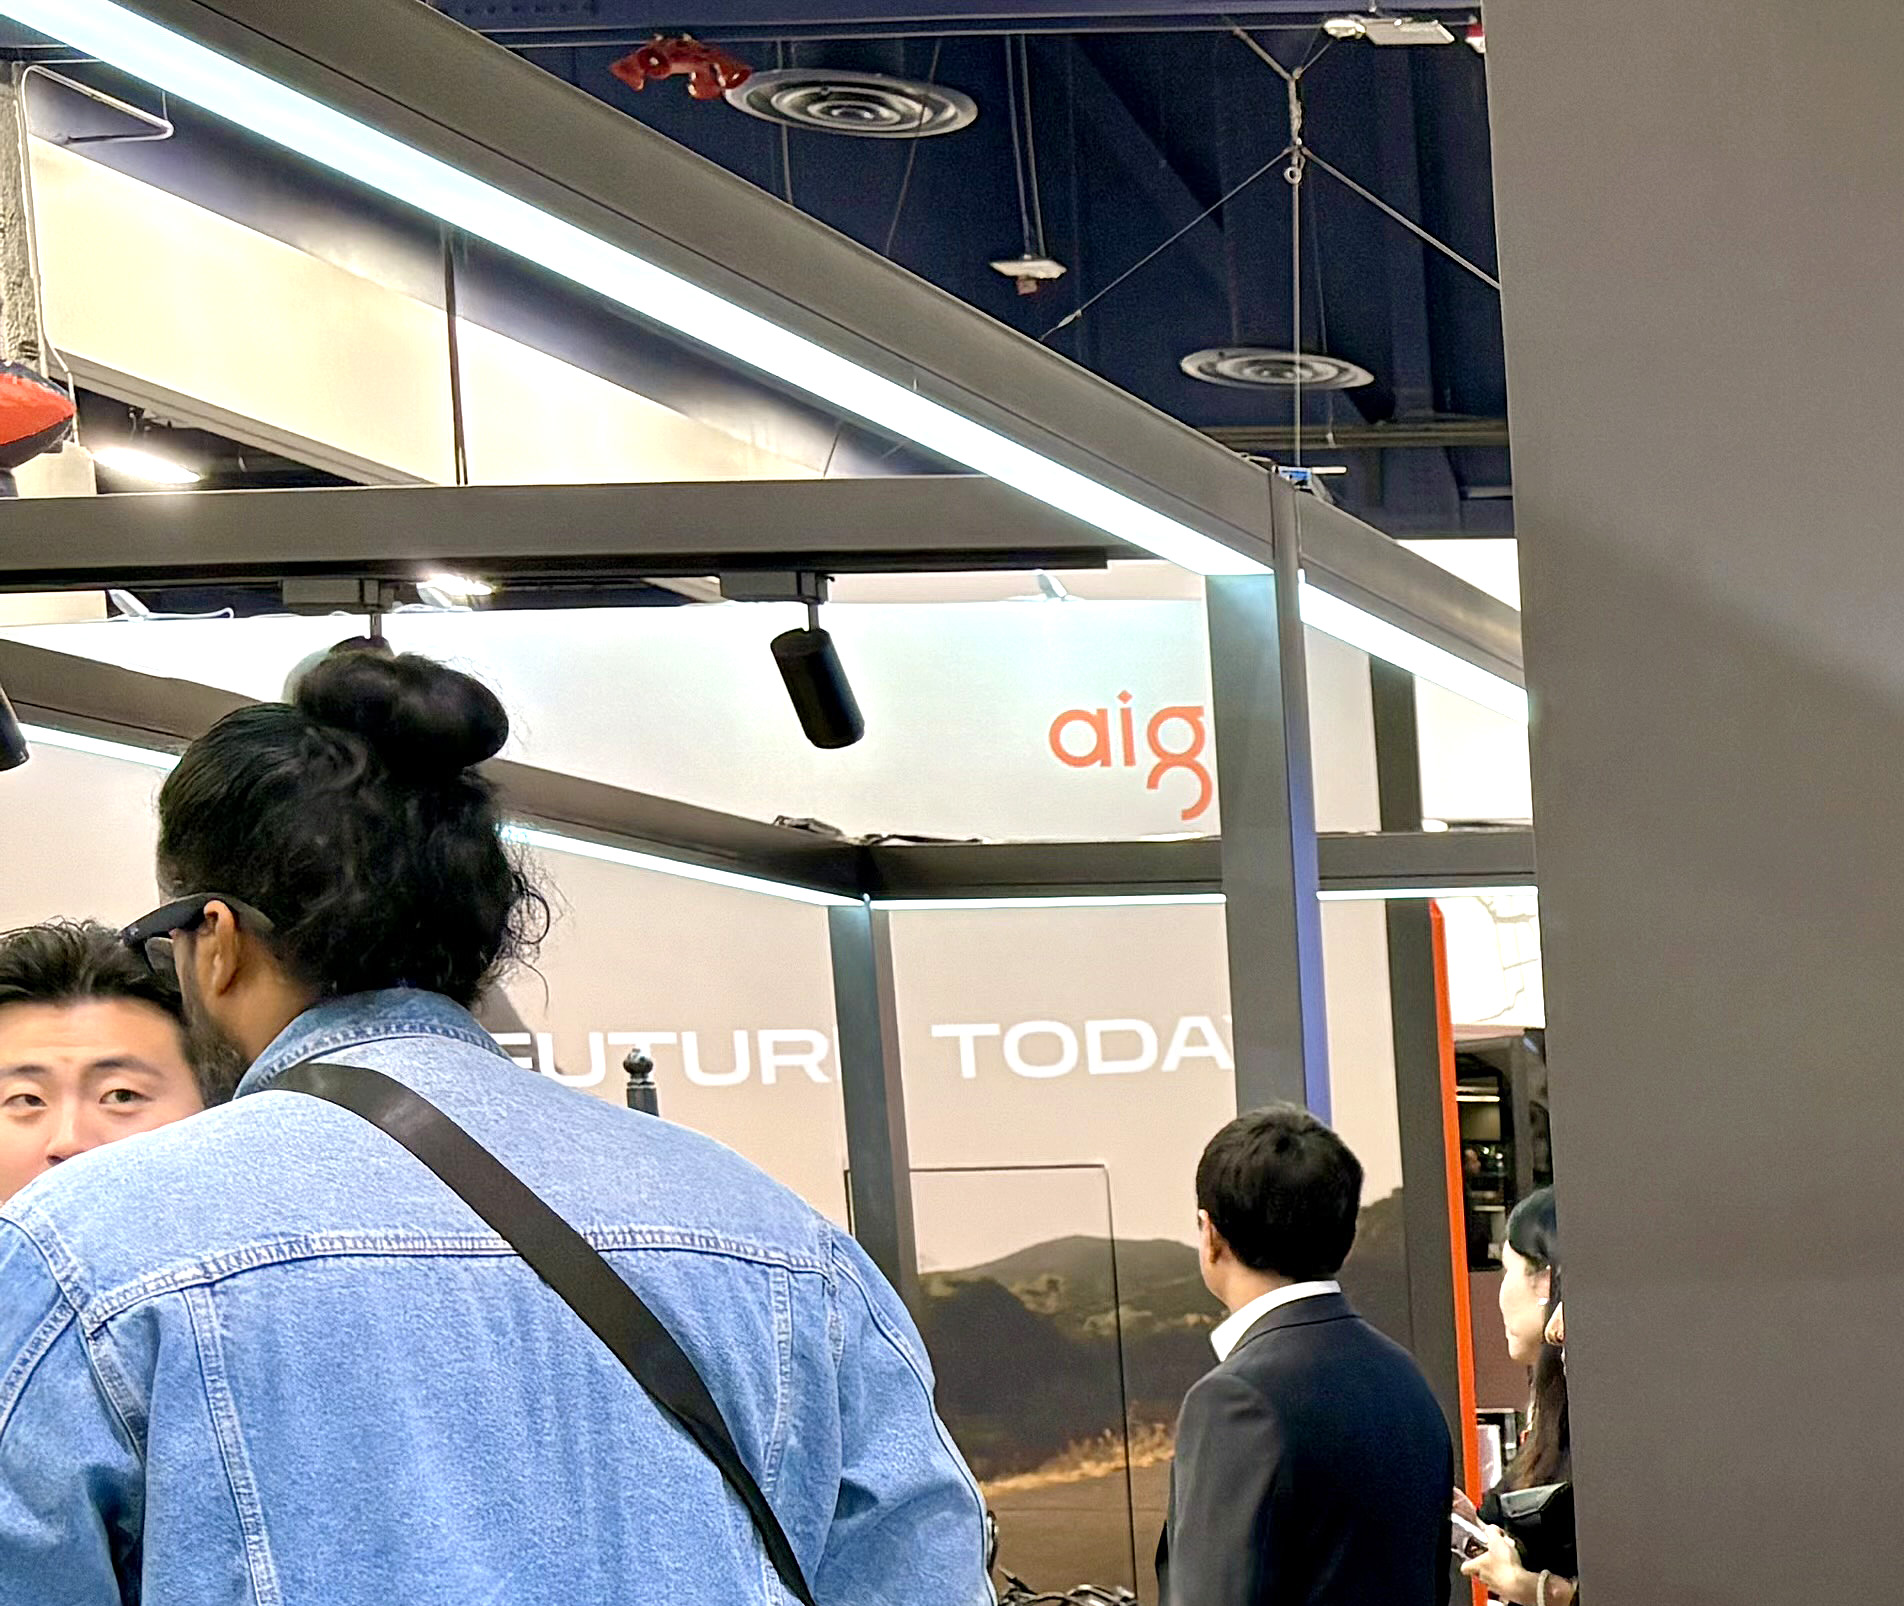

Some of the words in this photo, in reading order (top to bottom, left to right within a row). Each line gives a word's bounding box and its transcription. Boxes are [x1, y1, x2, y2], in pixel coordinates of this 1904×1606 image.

[1048, 689, 1213, 821] aig
[491, 1029, 842, 1088] FUTUR
[931, 1015, 1235, 1079] TODA
